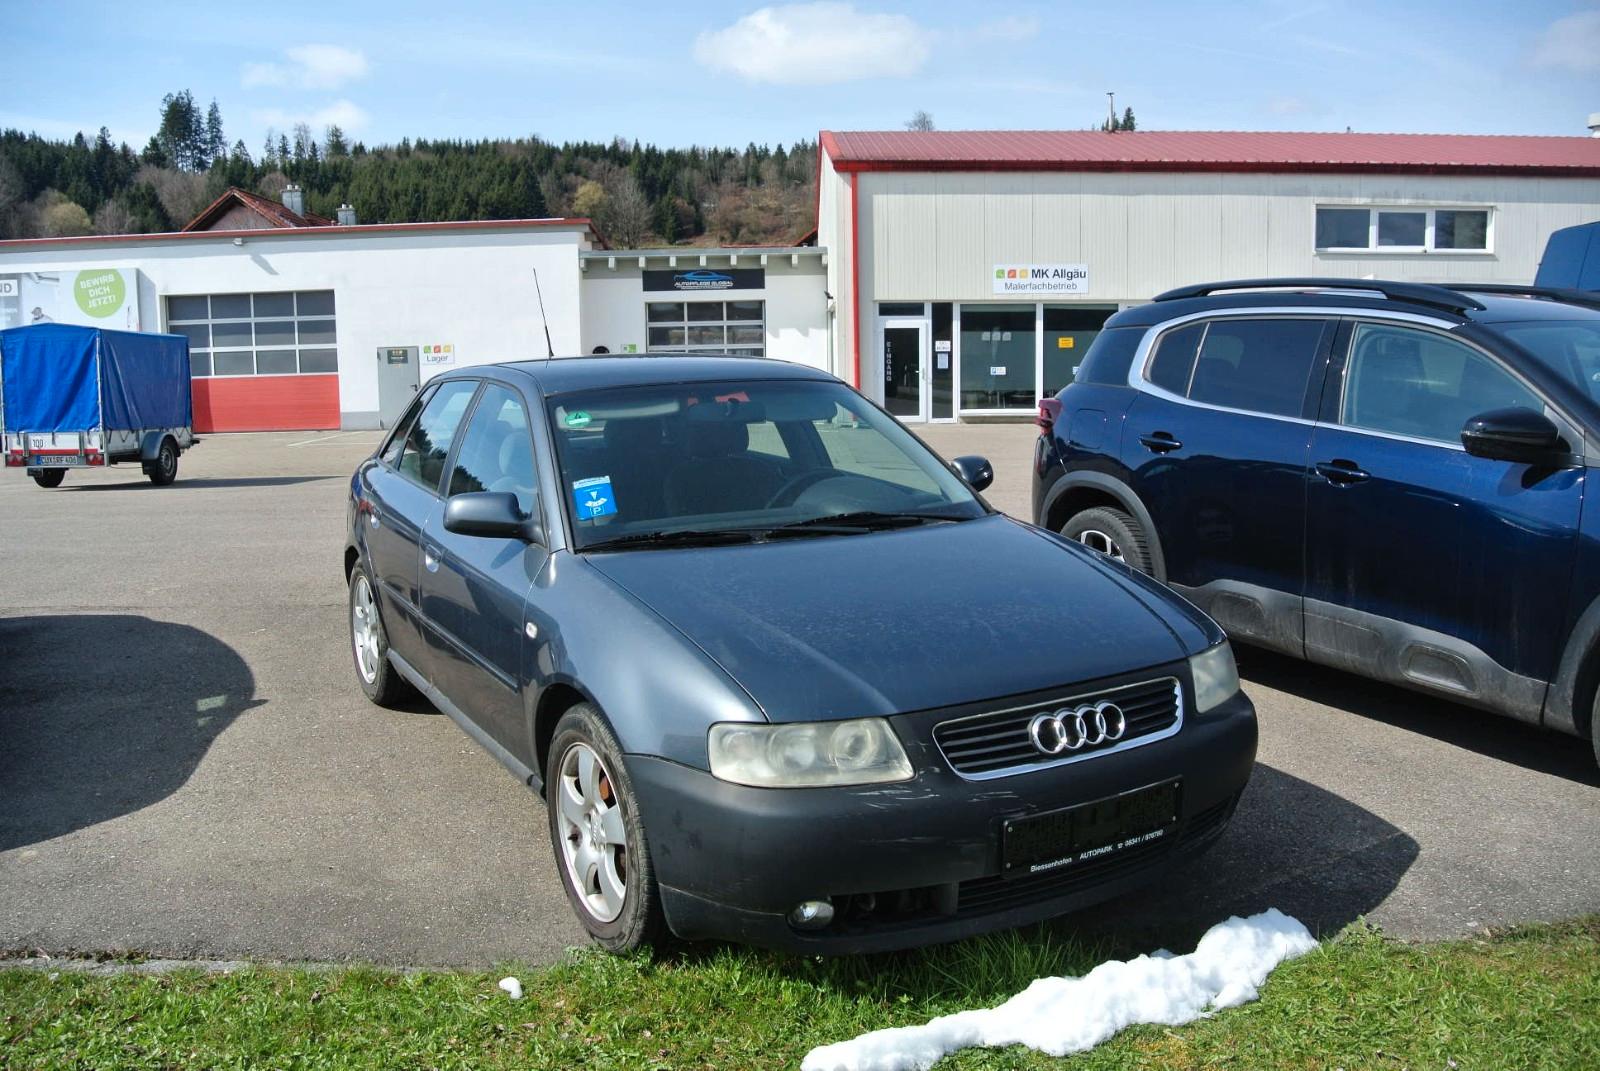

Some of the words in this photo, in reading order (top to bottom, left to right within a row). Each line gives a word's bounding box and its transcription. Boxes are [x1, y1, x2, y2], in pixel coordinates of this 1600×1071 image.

[1031, 269, 1049, 279] MK
[1052, 268, 1087, 281] Allgäu
[80, 274, 115, 289] BEWIRB
[1004, 282, 1078, 291] Malerfachbetrieb
[88, 285, 111, 298] DICH
[88, 295, 116, 308] JETZT!
[426, 355, 449, 363] Lager
[1080, 845, 1113, 860] AUTOPARK
